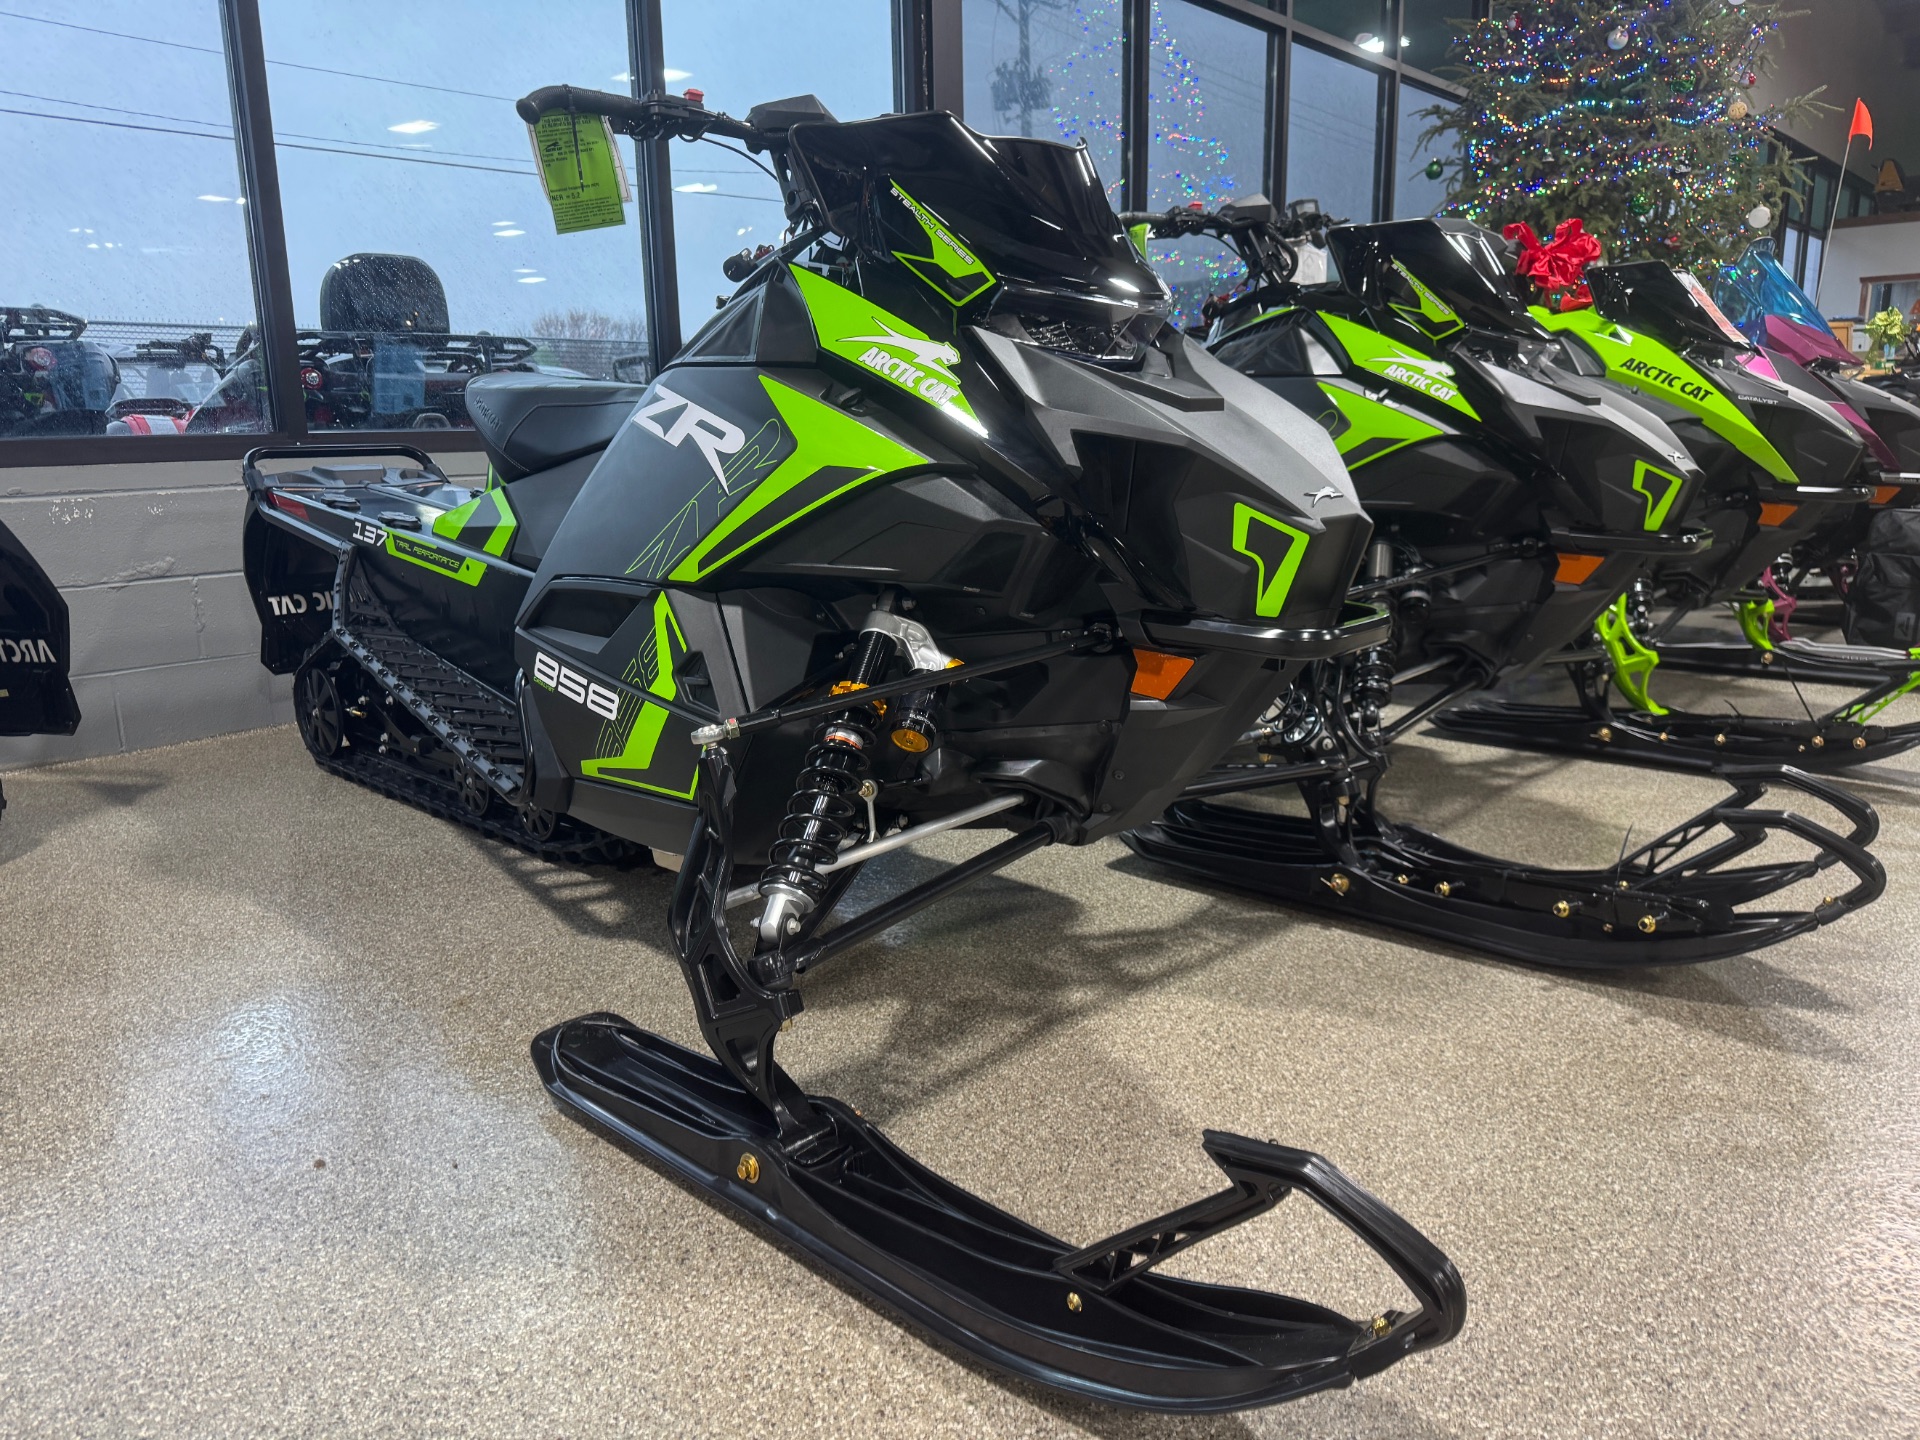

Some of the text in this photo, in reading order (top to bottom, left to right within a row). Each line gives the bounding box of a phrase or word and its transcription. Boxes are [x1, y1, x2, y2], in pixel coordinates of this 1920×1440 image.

[890, 187, 976, 266] STEALTH SERIES
[1391, 263, 1424, 292] STEALTH
[857, 346, 962, 408] ARCTIC CAT
[1383, 363, 1458, 401] ARCTIC CAT
[1619, 357, 1713, 402] ARCTIC CAT
[1737, 394, 1779, 405] CATALYST
[631, 383, 746, 496] ZR
[352, 521, 388, 547] 137
[412, 546, 460, 569] PERFORMANCE
[533, 651, 620, 721] 858
